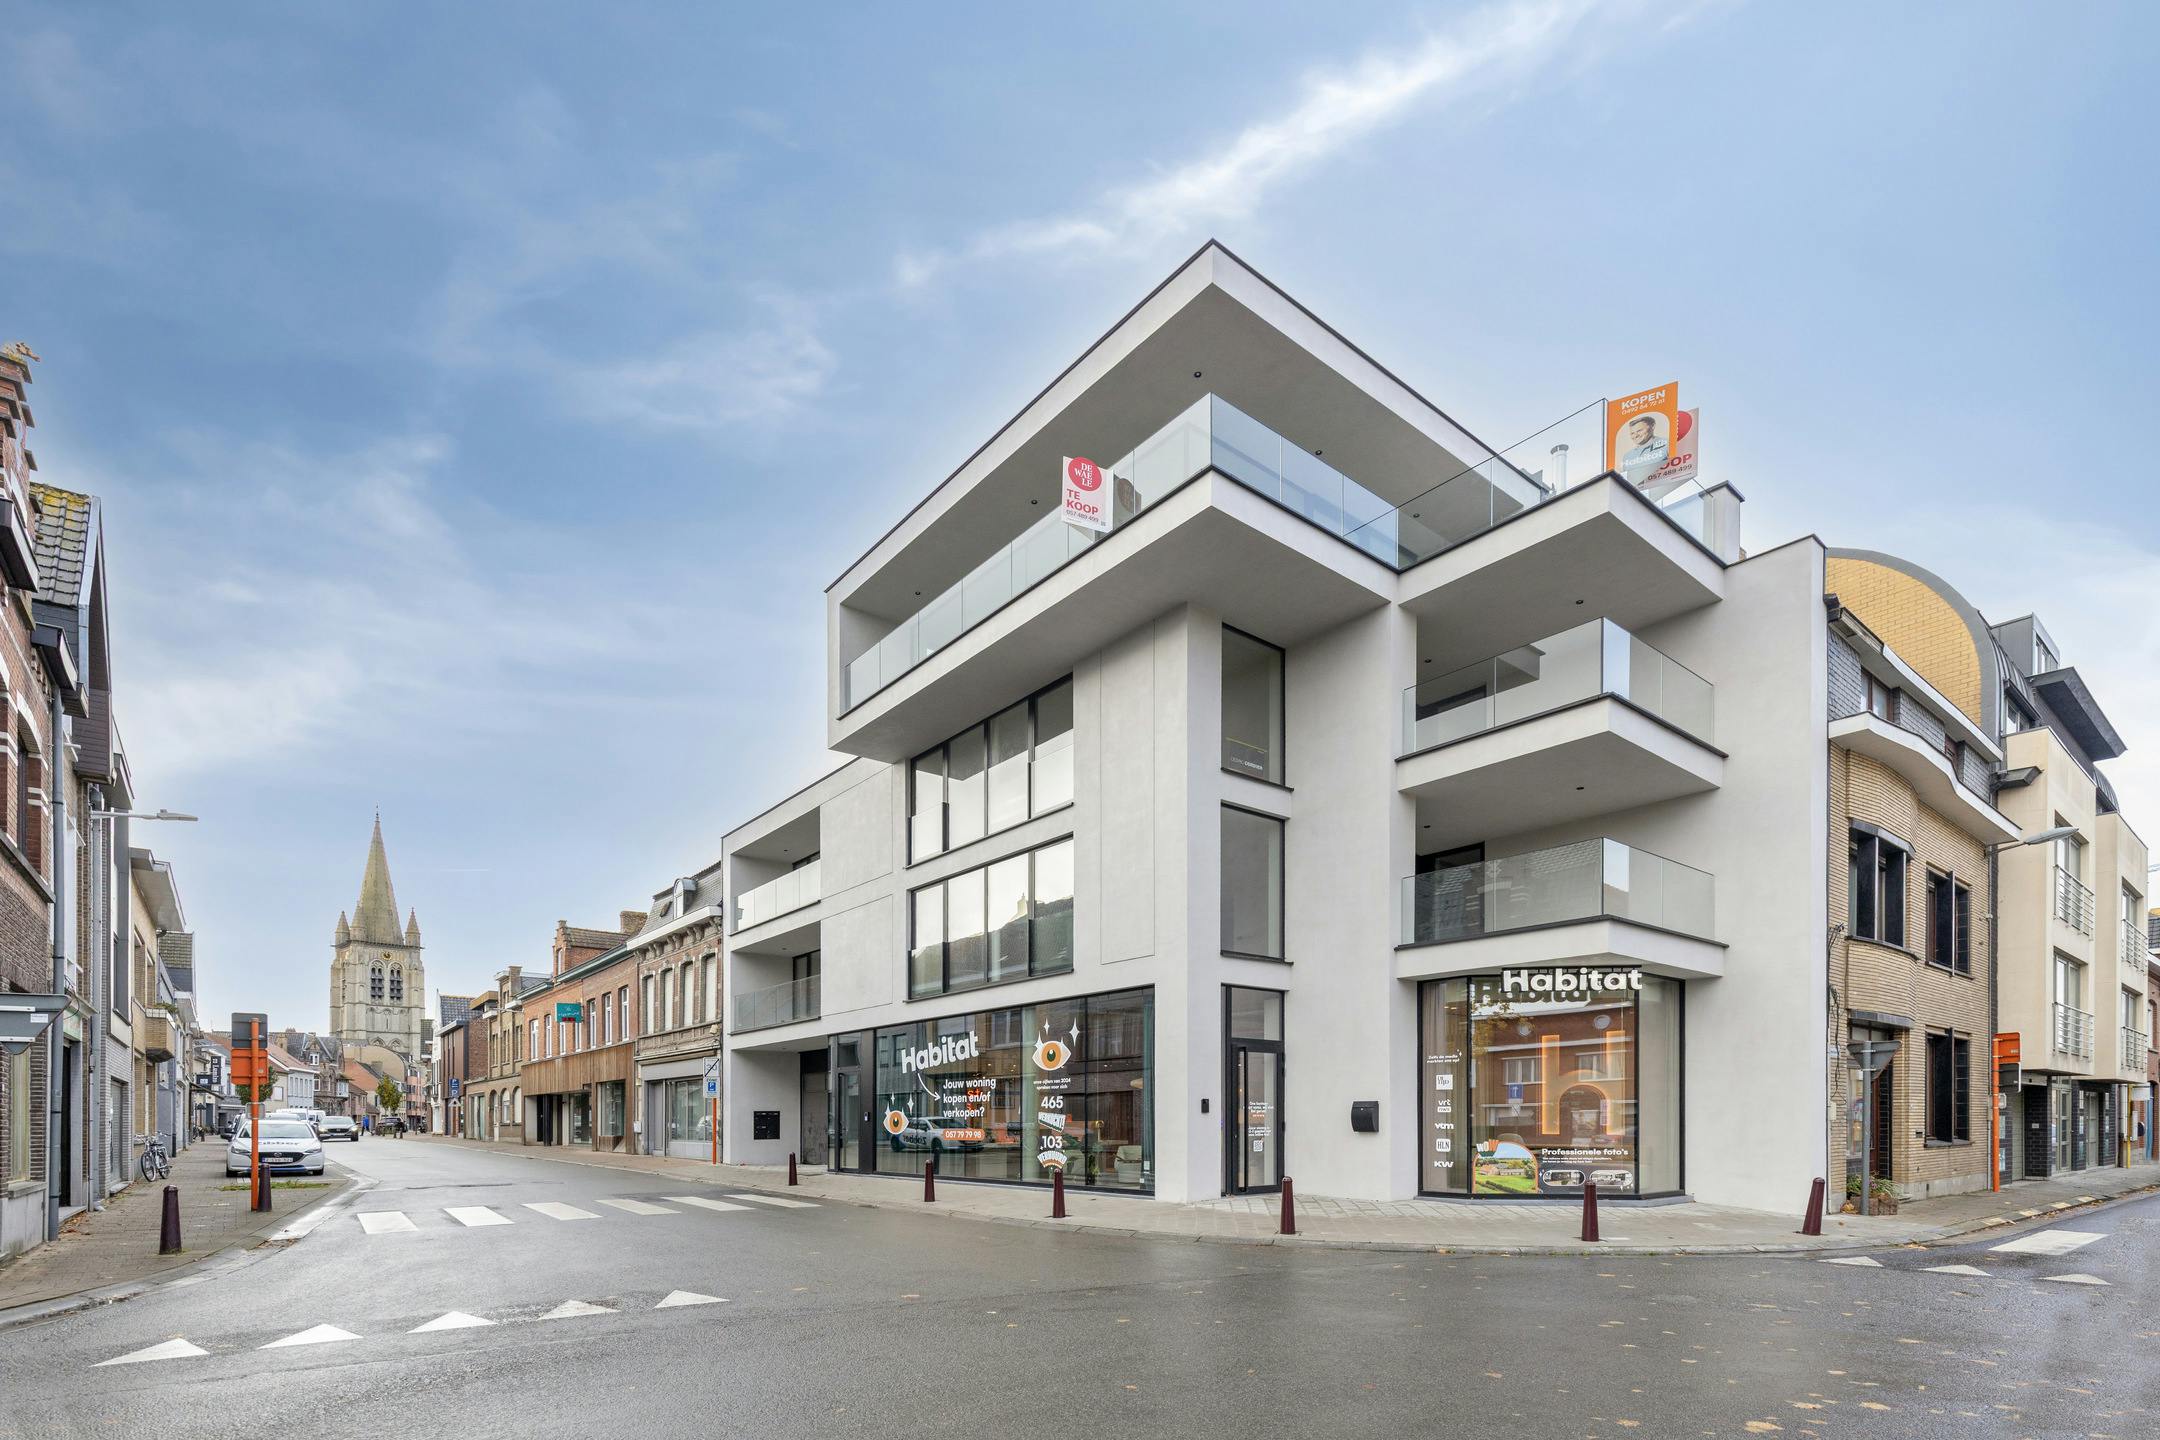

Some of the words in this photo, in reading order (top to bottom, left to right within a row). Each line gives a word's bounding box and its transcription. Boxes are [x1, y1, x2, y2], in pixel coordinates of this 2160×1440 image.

[1622, 390, 1665, 410] KOPEN
[1081, 463, 1093, 471] DE
[1074, 468, 1093, 480] WAE
[1082, 478, 1093, 487] LE
[1067, 488, 1080, 500] TE
[1067, 499, 1098, 514] KOOP
[1503, 967, 1642, 992] Habitat
[901, 1030, 979, 1074] Habitat
[943, 1079, 964, 1089] Jouw
[966, 1077, 997, 1090] woning
[943, 1093, 967, 1105] kopen
[969, 1091, 991, 1102] en/of
[1041, 1096, 1064, 1109] 465
[943, 1106, 985, 1120] verkopen?
[1042, 1136, 1063, 1148] 103
[1438, 1141, 1450, 1149] HLN
